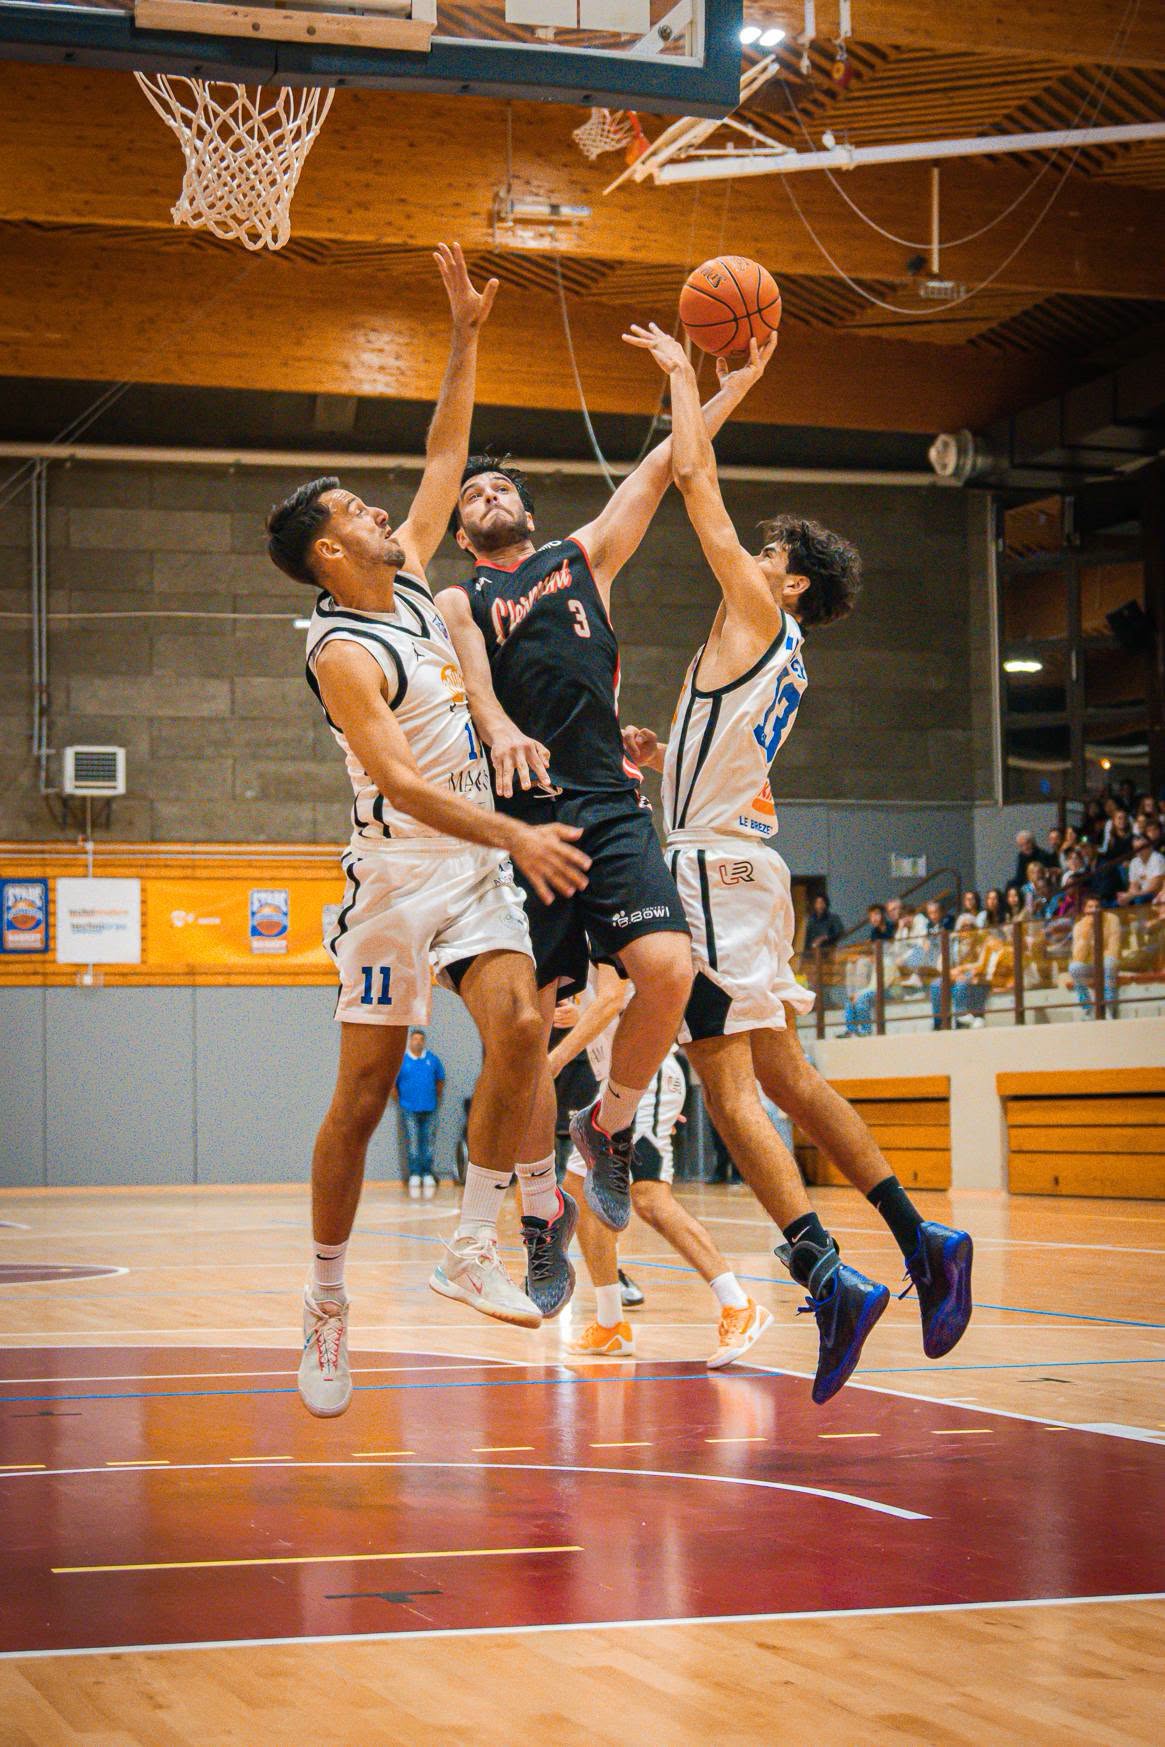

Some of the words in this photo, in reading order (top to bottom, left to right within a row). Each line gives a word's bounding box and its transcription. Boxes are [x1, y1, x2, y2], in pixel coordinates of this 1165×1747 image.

[567, 599, 592, 638] 3
[739, 815, 748, 827] LE
[360, 966, 392, 1005] 11
